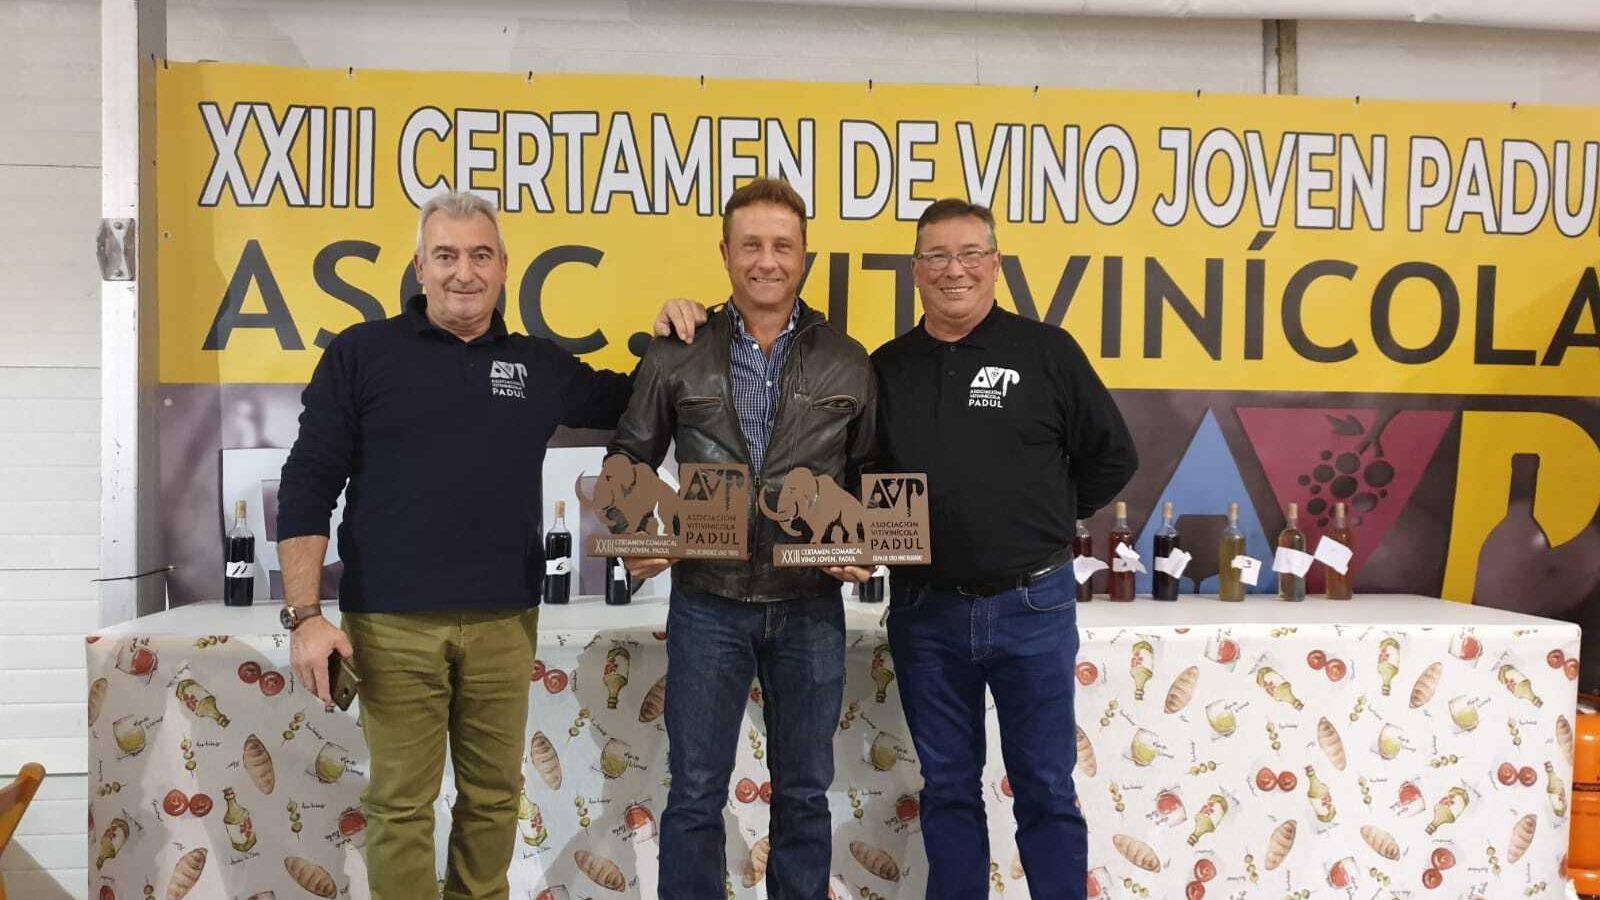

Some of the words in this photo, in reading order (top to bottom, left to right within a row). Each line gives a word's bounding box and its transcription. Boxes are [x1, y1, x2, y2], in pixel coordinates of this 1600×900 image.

[198, 101, 376, 209] XXIII
[397, 106, 816, 218] CERTAMEN
[839, 119, 939, 222] DE
[954, 121, 1139, 226] VINO
[1153, 126, 1388, 231] JOVEN
[1408, 136, 1600, 238] PADU
[492, 387, 526, 399] PADUL
[968, 399, 1004, 408] PADUL
[686, 531, 740, 545] PADUL
[870, 538, 924, 551] PADUL
[595, 538, 614, 553] XXIII
[781, 549, 800, 563] XXIII
